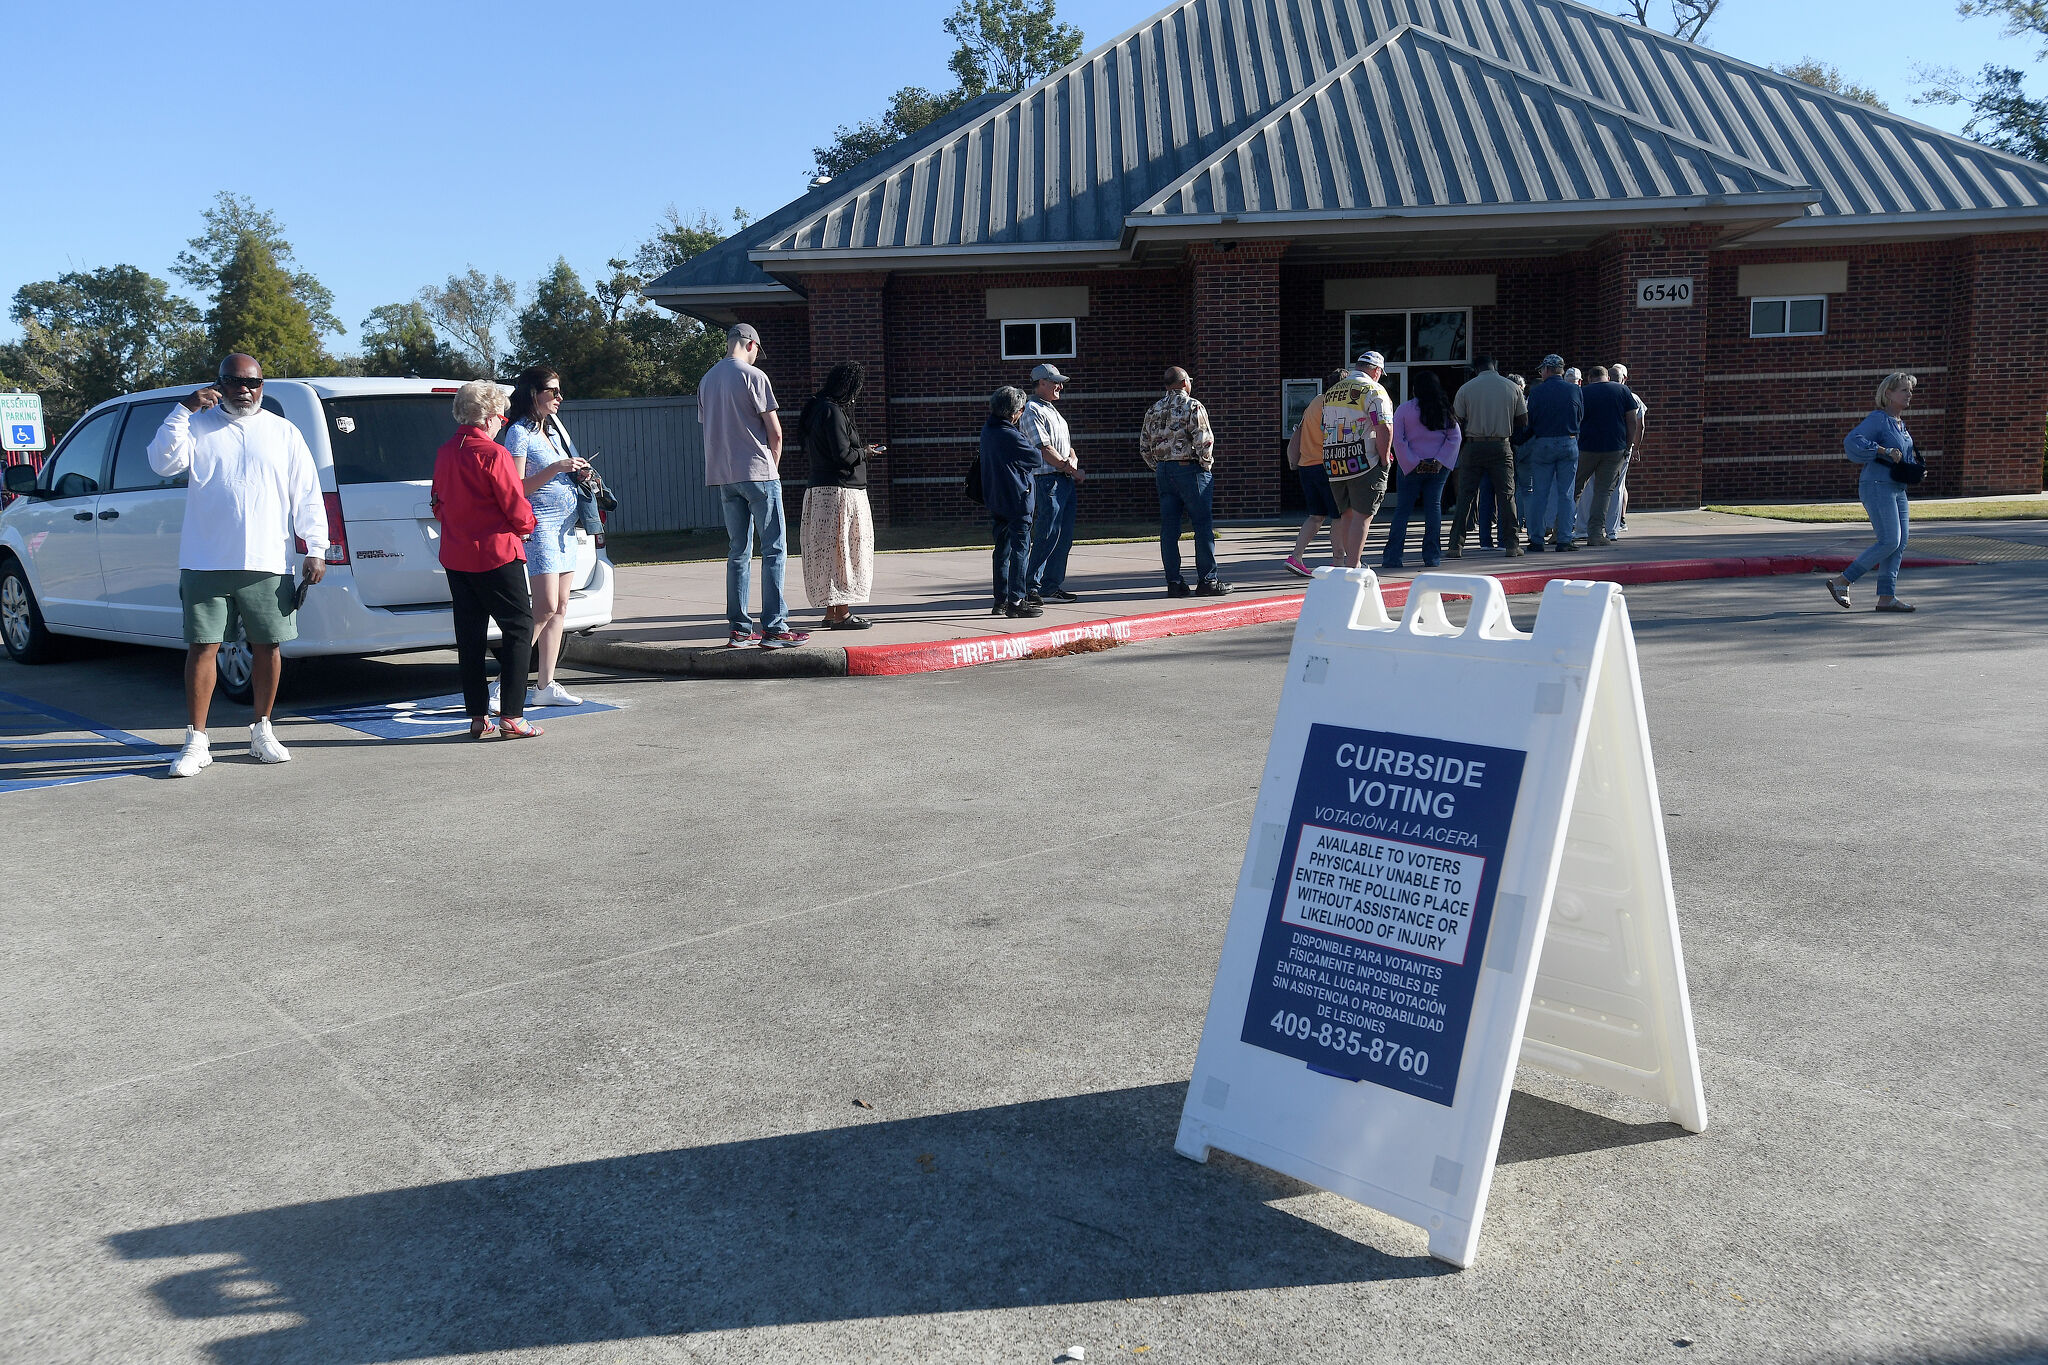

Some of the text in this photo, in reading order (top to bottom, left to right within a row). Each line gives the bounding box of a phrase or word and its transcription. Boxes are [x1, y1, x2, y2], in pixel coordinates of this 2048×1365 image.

[1643, 284, 1689, 301] 6540
[2, 400, 37, 408] RESERVED
[6, 412, 36, 420] PARKING
[1325, 390, 1348, 403] OFFEE
[1325, 456, 1368, 475] COHOL
[1335, 448, 1346, 458] JOB
[1348, 444, 1363, 457] FOR
[951, 642, 989, 664] FIRE
[993, 637, 1032, 659] LANE
[1074, 622, 1131, 641] PARKING
[1335, 742, 1486, 788] CURBSIDE
[1348, 777, 1456, 819] VOTING
[1314, 805, 1478, 849] VOTACIÓN A LA ACERA
[1308, 851, 1462, 895] PHYSICALLY UNABLE TO
[1316, 834, 1461, 875] AVAILABLE TO VOTERS
[1295, 866, 1470, 917] ENTER THE POLLING PLACE
[1297, 885, 1458, 935] WITHOUT ASSISTANCE OR
[1300, 905, 1447, 952] LIKELIHOOD OF INJURY
[1288, 947, 1440, 997] FÍSICAMENTE INPOSIBLES DE
[1291, 931, 1443, 980] DISPONIBLE PARA VOTANTES
[1272, 974, 1444, 1033] SIN ASISTENCIA O PROBABILIDAD
[1276, 959, 1447, 1016] ENTRAR AL LUGAR DE VOTACIÓN
[1316, 1003, 1386, 1034] DE LESIONES
[1269, 1009, 1429, 1076] 409-835-8760
